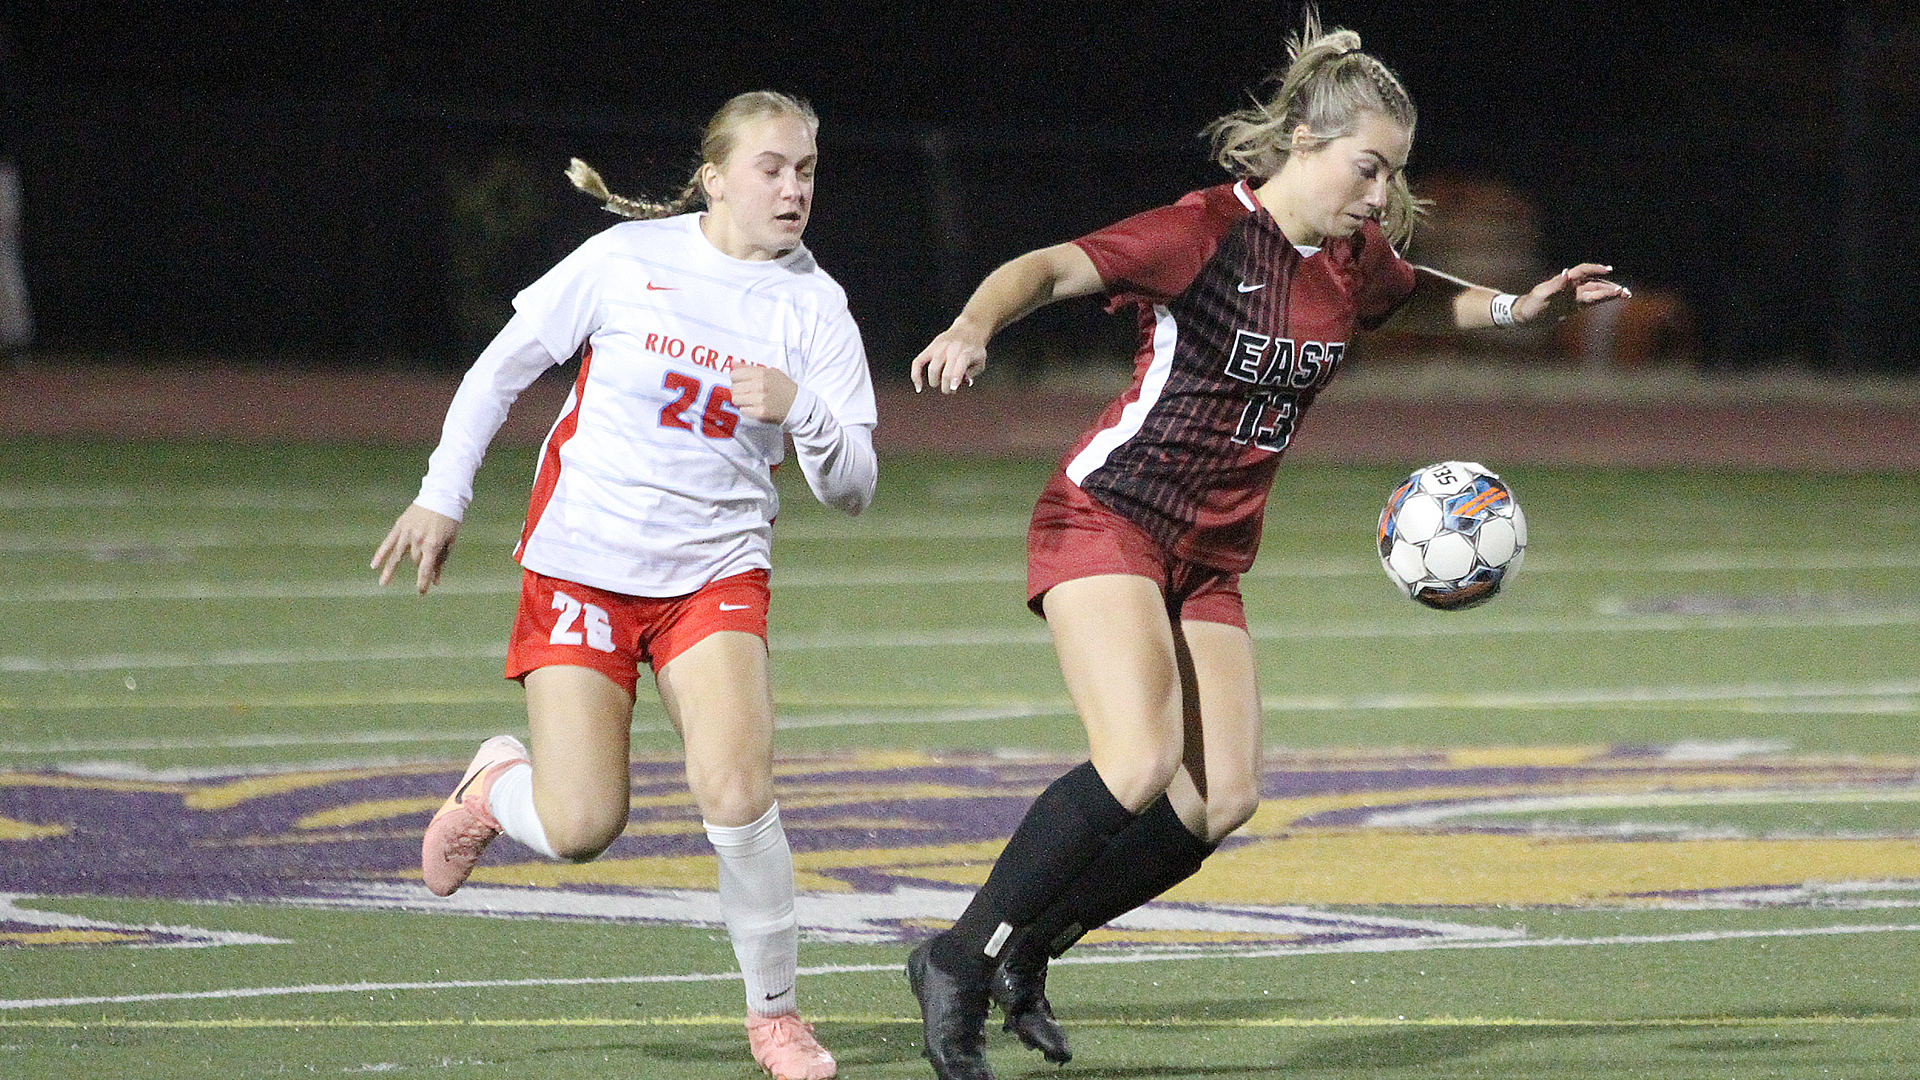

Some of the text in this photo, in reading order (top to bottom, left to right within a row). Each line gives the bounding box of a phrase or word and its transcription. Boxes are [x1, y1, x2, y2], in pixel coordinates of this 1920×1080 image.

[645, 333, 780, 373] RIO GRA
[1224, 329, 1345, 388] EAST
[657, 369, 741, 440] 26
[1231, 391, 1299, 452] 13
[549, 591, 616, 653] 26
